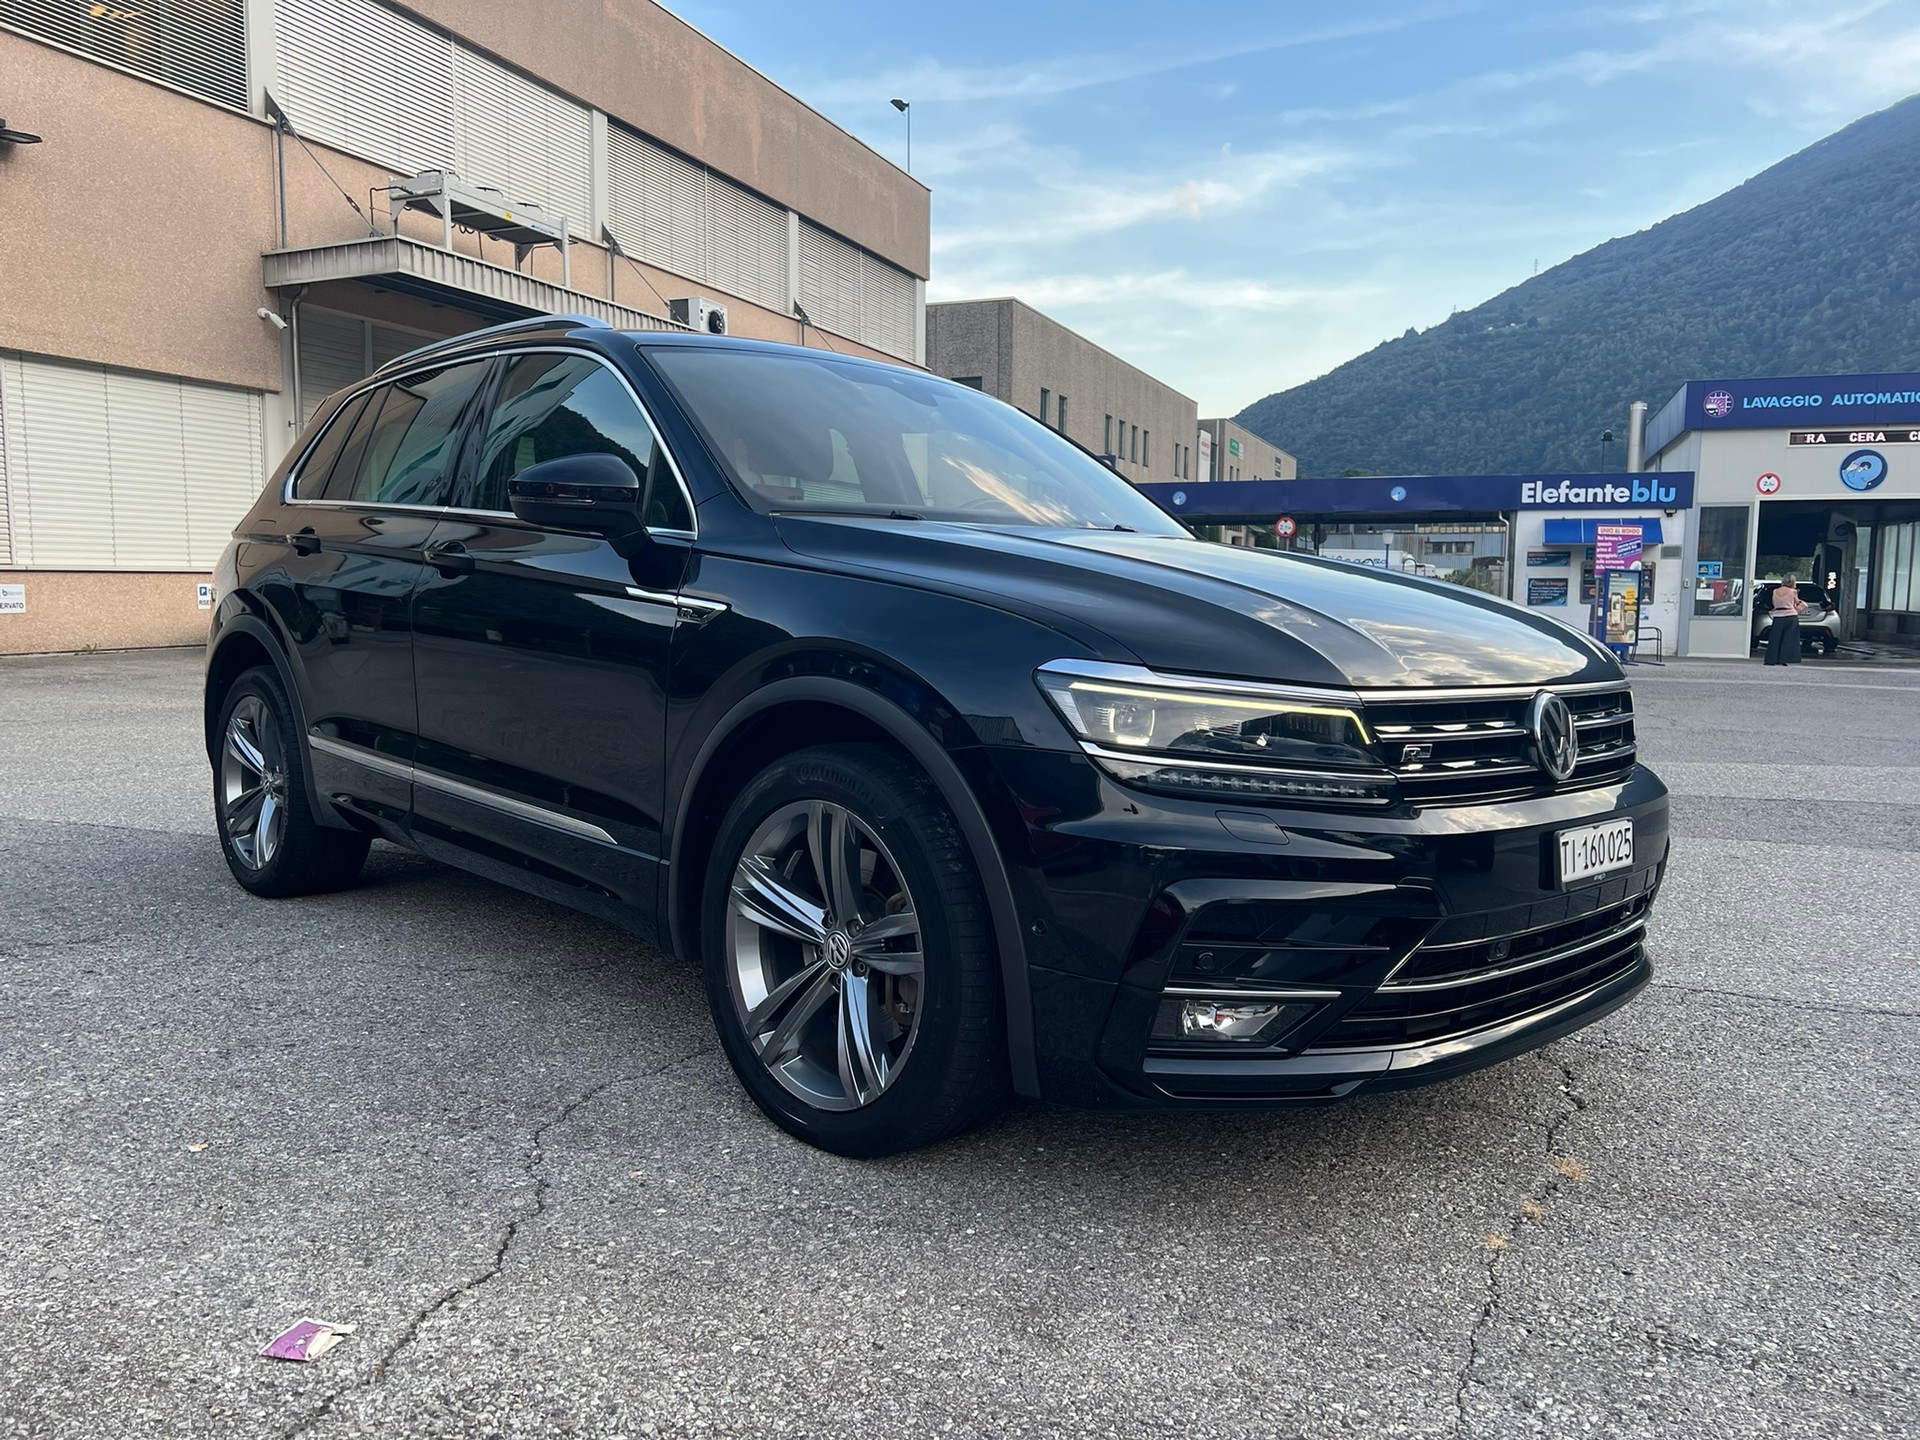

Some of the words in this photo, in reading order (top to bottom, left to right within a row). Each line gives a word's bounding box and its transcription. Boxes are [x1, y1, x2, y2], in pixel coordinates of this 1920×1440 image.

[1743, 394, 1823, 409] LAVAGGIO
[1804, 433, 1827, 444] RA
[1849, 431, 1886, 443] CERA
